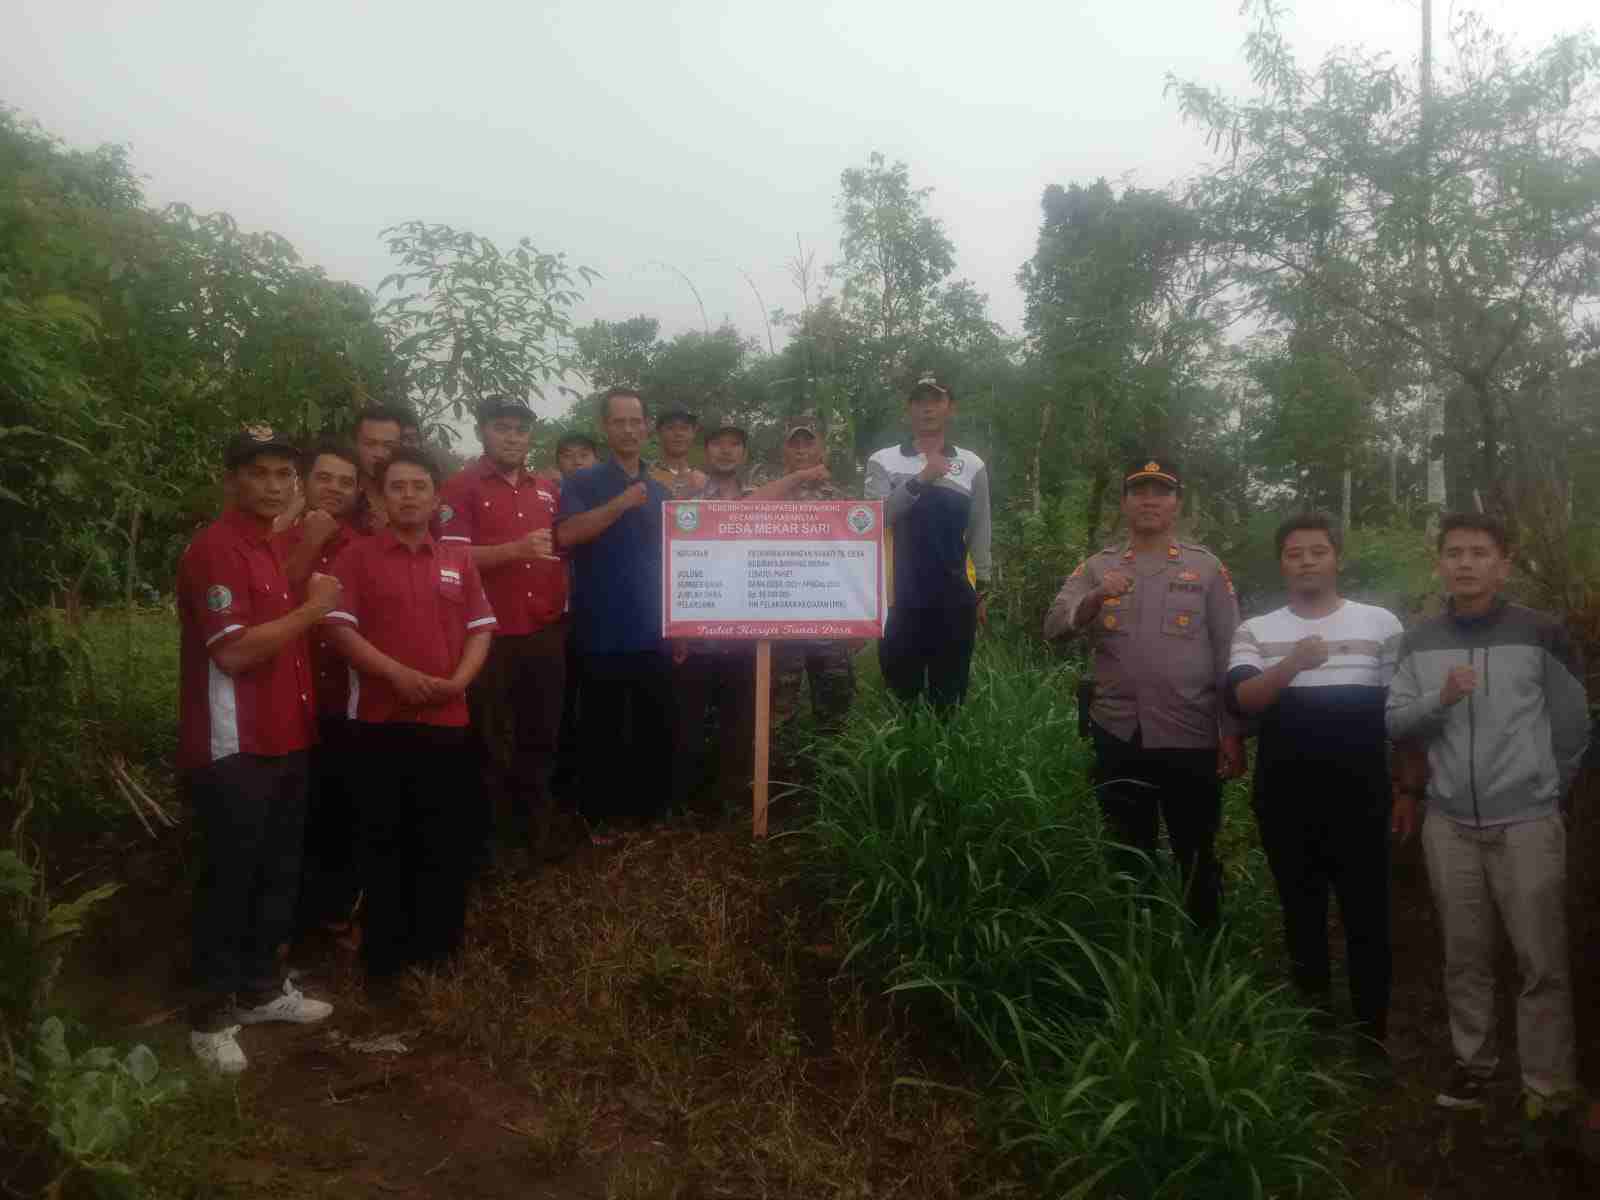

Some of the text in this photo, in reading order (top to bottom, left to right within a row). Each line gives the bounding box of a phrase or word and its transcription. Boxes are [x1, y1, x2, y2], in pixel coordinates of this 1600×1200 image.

[719, 523, 831, 534] DESA MEKAR SARI
[822, 624, 852, 635] Desa
